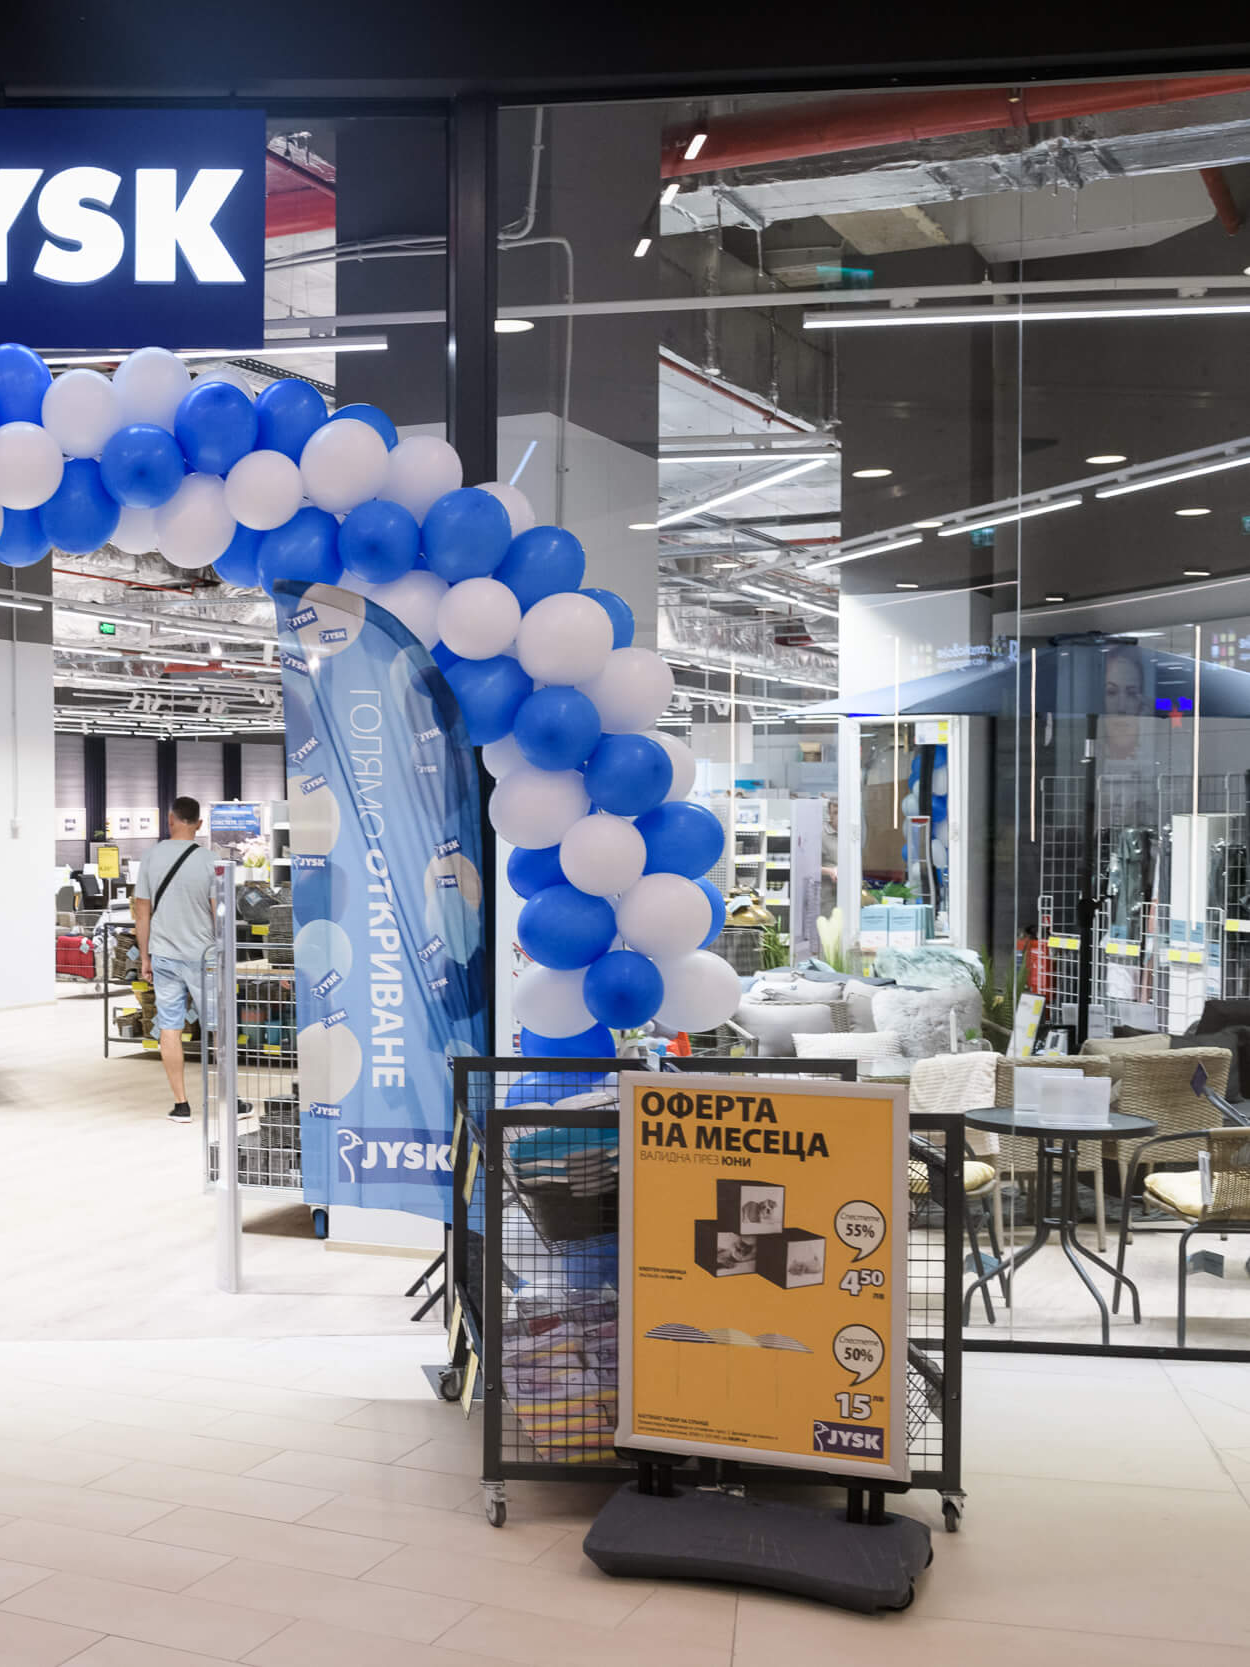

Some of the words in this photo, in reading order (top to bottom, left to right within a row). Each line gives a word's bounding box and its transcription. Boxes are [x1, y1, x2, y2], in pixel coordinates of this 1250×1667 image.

[292, 611, 316, 626] JYSK
[324, 631, 346, 640] JYSK
[420, 728, 440, 741] JYSK
[299, 738, 318, 761] JYSK
[350, 690, 384, 838] ГОЛЯМО
[307, 776, 326, 789] JYSK
[438, 840, 460, 855] JYSK
[301, 858, 325, 867] JYSK
[423, 939, 442, 958] JYSK
[366, 849, 406, 1088] ОТКРИВАНЕ
[319, 974, 340, 994] JYSK
[327, 1010, 346, 1023] JYSK
[317, 1106, 340, 1116] JYSK
[641, 1091, 778, 1124] ОФЕРТА
[641, 1121, 687, 1149] НА
[696, 1125, 829, 1162] МЕСЕЦА
[361, 1141, 453, 1171] JYSK
[640, 1150, 691, 1164] ВАЛИДНА
[694, 1153, 719, 1166] ПРЕЗ
[721, 1155, 751, 1168] ЮНИ
[846, 1223, 875, 1238] 55%
[844, 1347, 873, 1362] 50%
[835, 1392, 872, 1420] 15
[827, 1429, 881, 1451] JYSK
